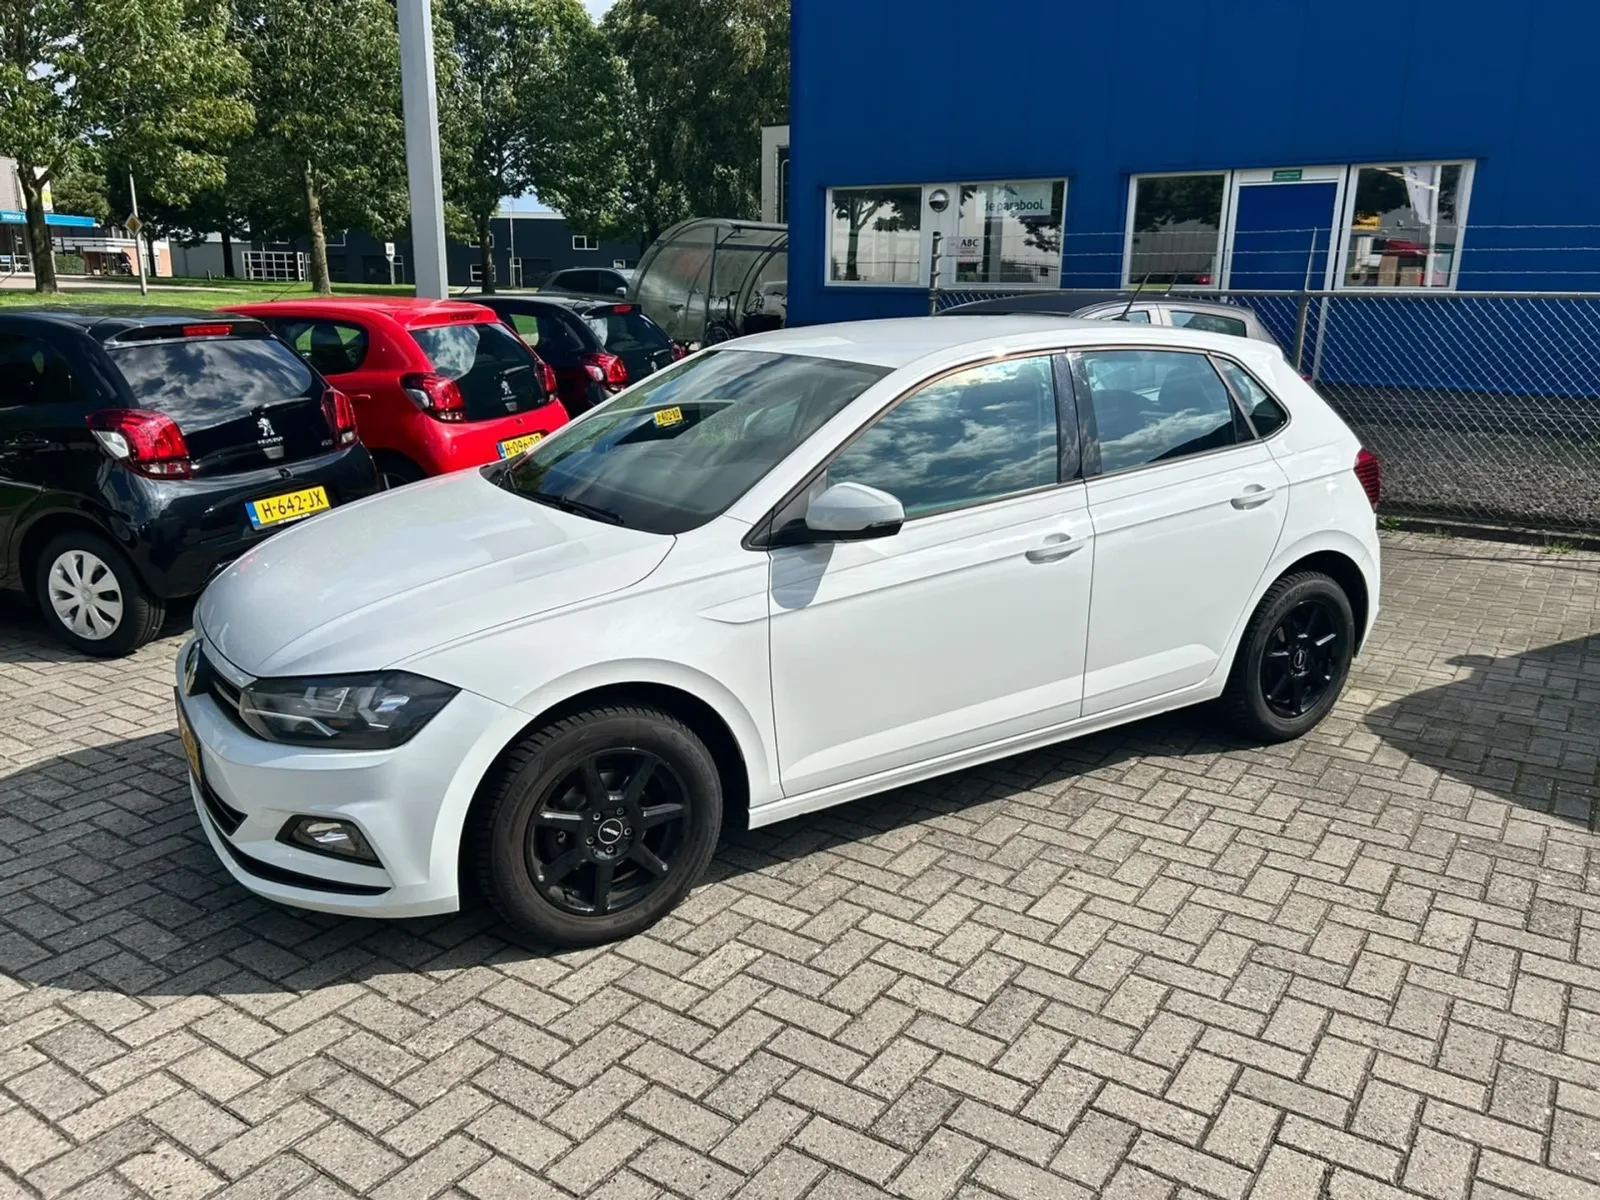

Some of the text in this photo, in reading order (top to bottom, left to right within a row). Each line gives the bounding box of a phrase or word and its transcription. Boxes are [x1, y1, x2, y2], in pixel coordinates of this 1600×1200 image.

[997, 198, 1044, 215] parabool
[961, 239, 979, 247] ABC
[261, 490, 325, 518] H-642-JX
